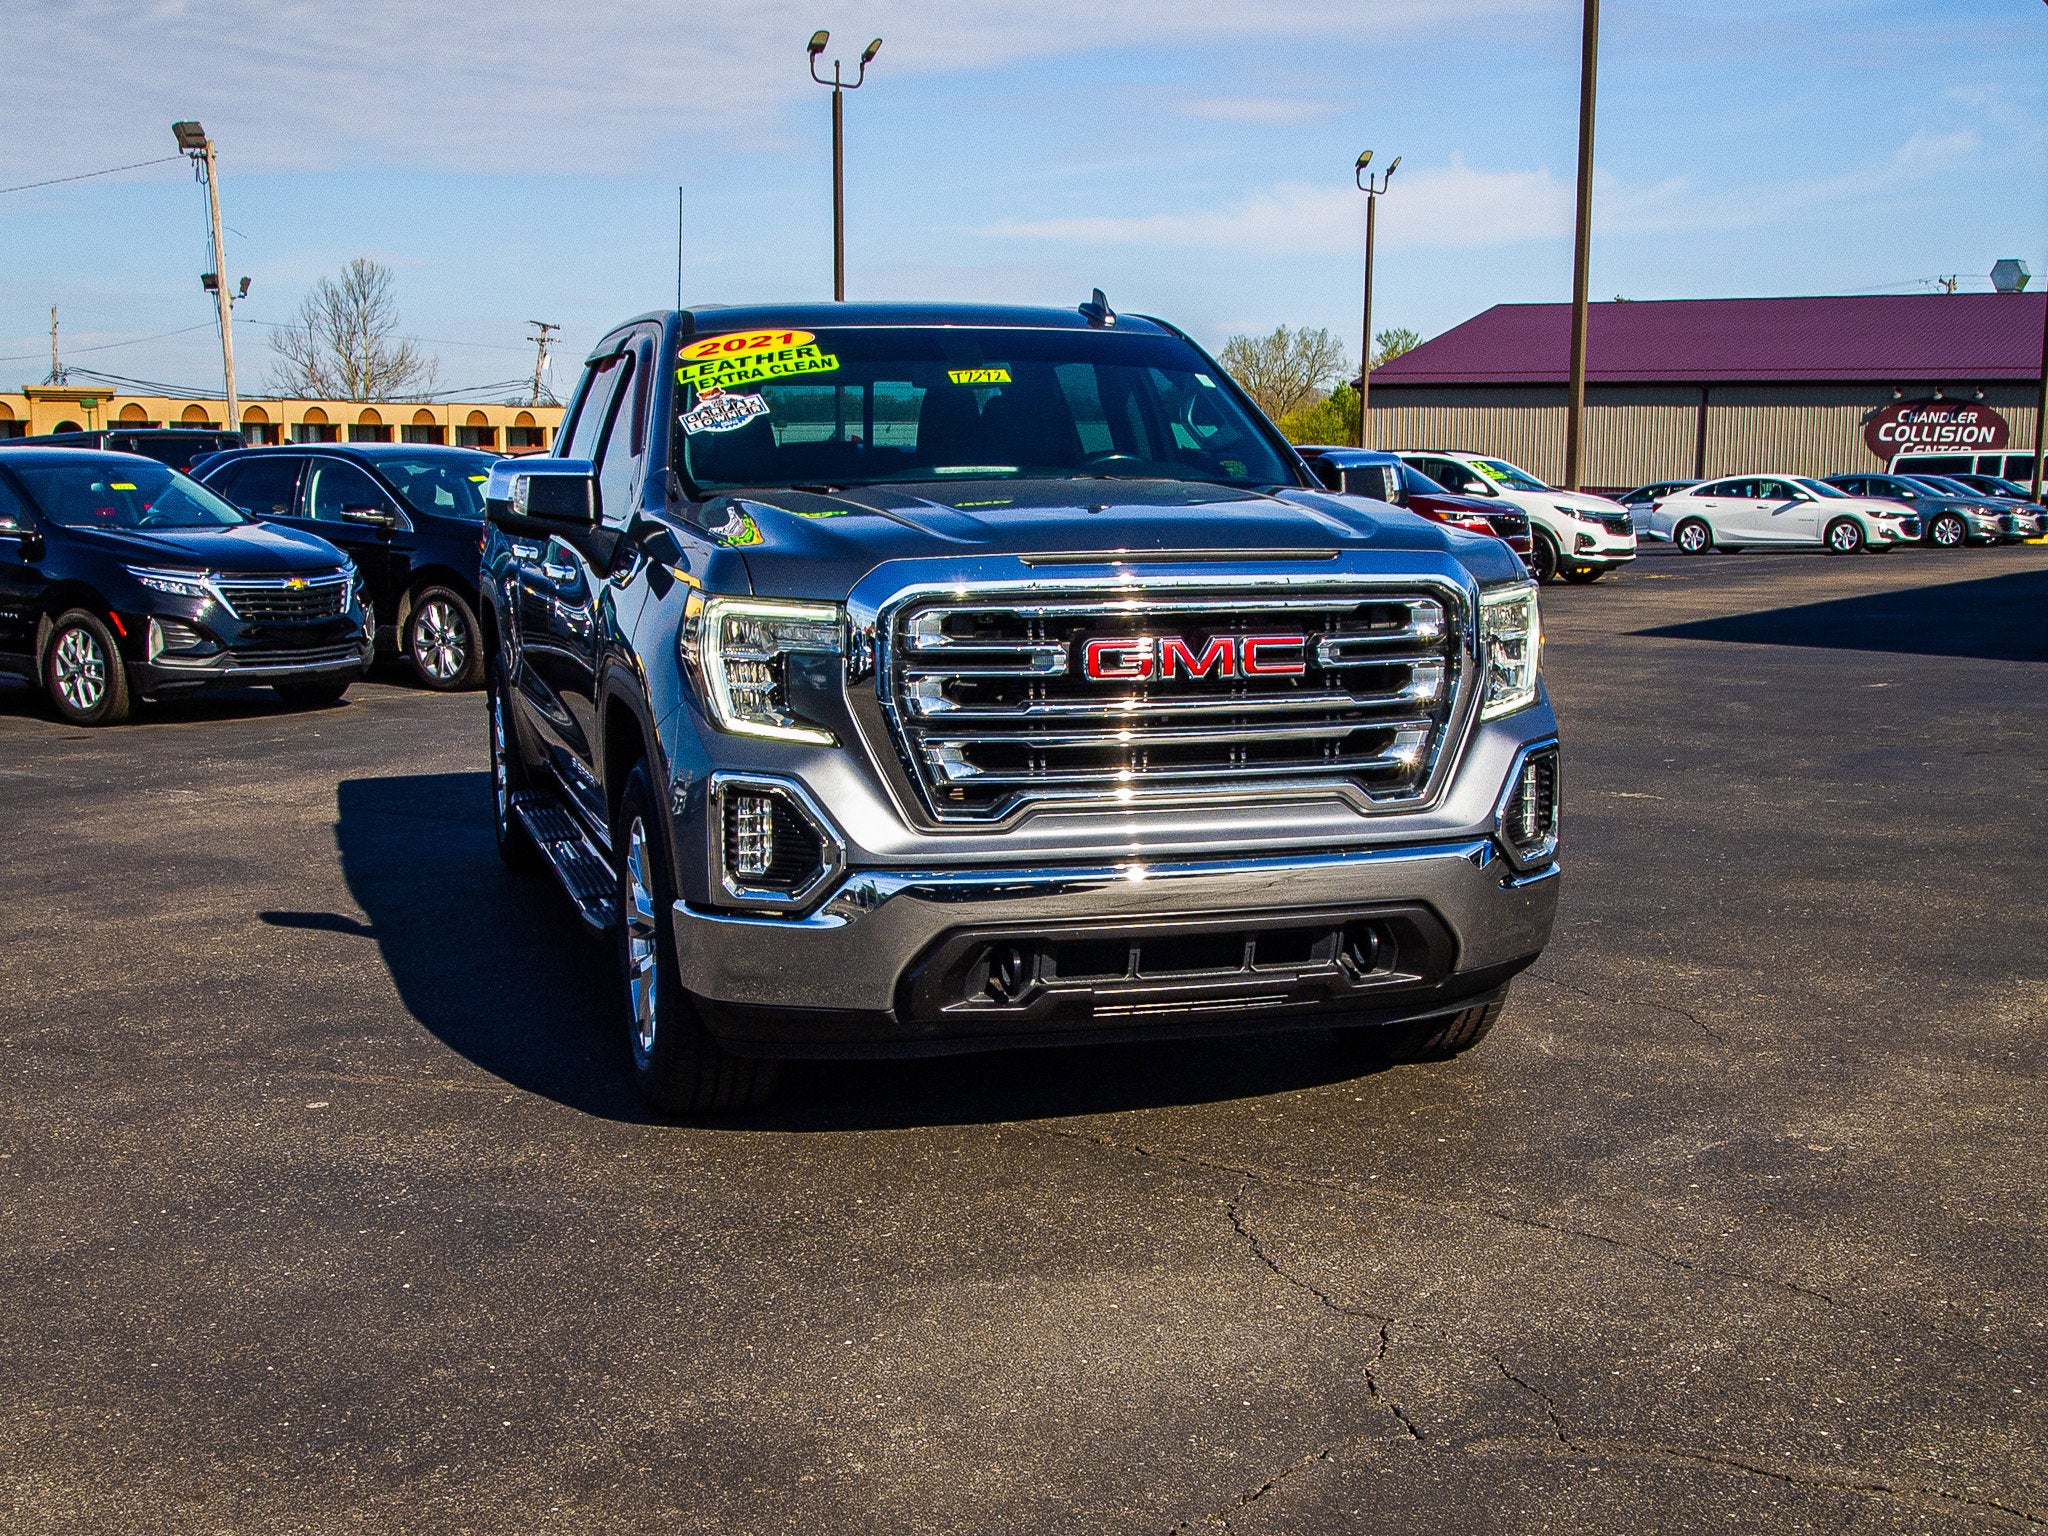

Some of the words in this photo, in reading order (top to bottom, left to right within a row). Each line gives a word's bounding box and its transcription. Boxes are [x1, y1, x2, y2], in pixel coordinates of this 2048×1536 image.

[697, 333, 793, 358] 2021
[682, 347, 814, 381] LEATHER
[698, 368, 764, 390] EXTRA
[770, 357, 833, 375] CLEAN
[1897, 409, 1978, 423] CHANDLER
[1878, 422, 1996, 443] COLLISION
[1083, 636, 1306, 682] GMC
